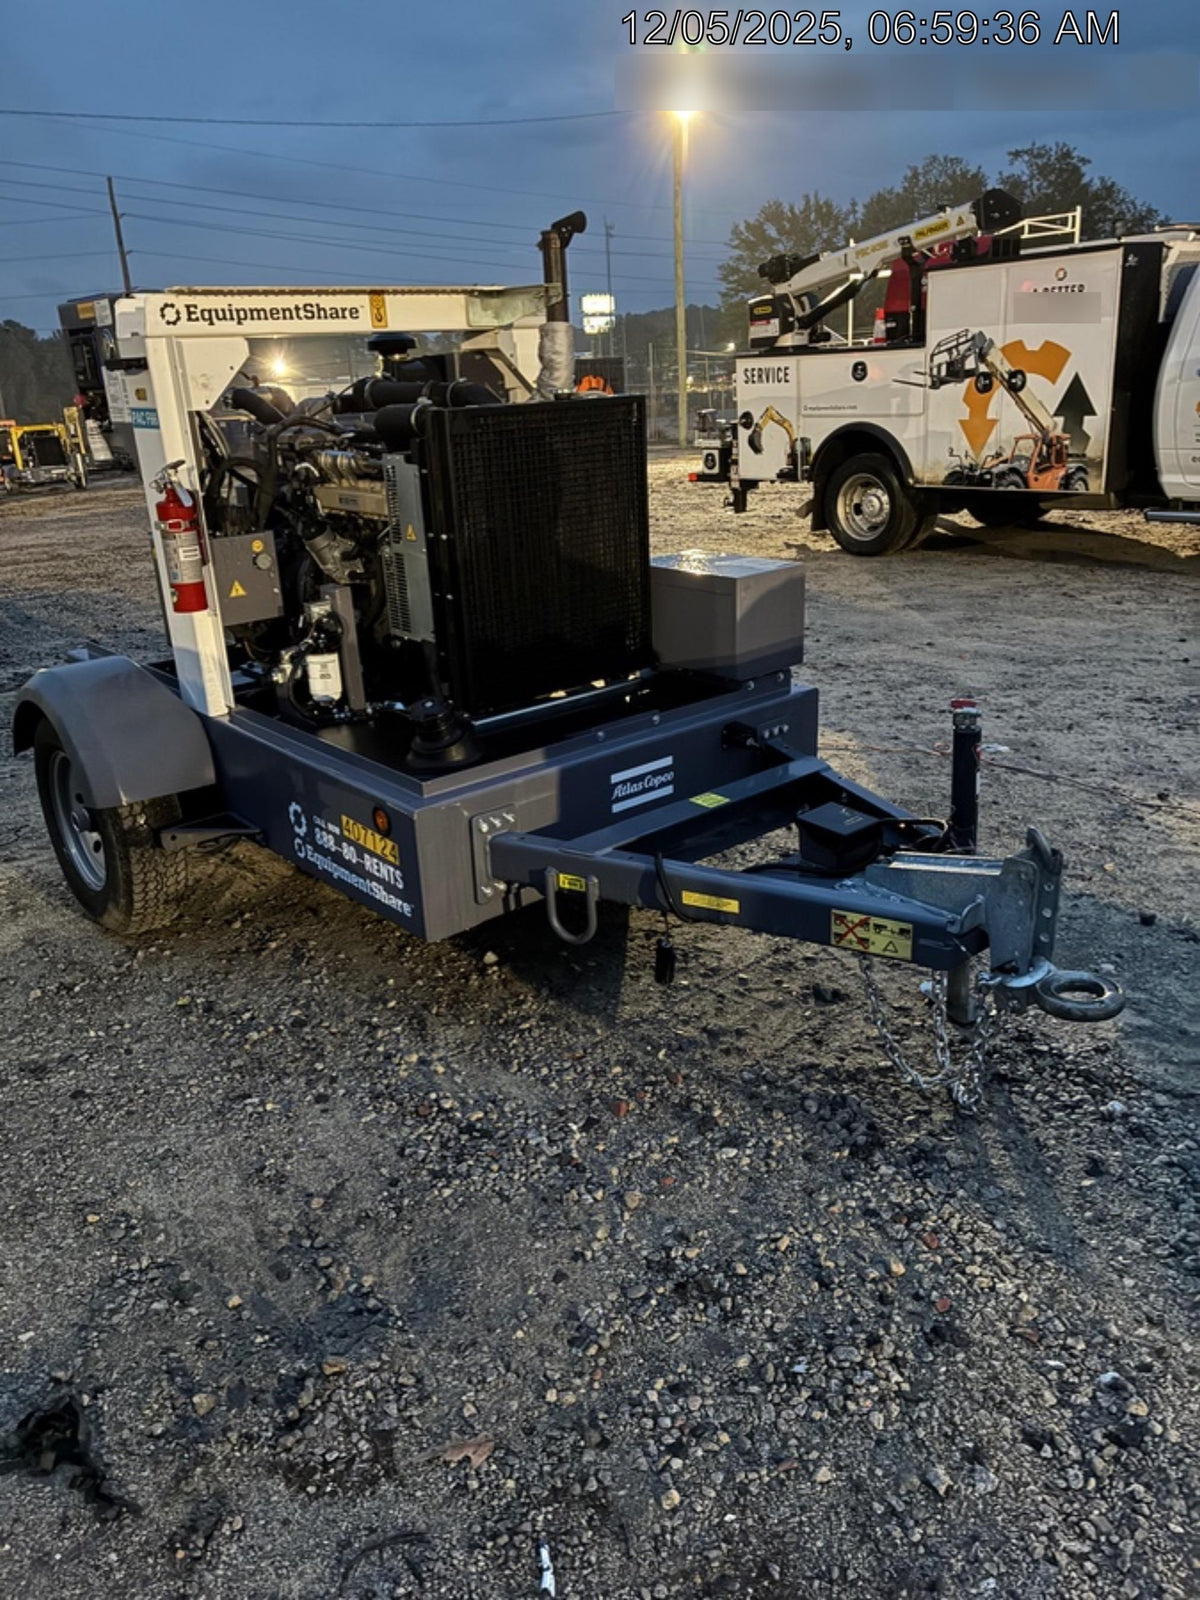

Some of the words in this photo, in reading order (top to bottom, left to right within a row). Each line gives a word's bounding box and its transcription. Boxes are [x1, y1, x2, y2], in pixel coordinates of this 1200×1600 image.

[184, 303, 360, 326] EquipmentShare
[743, 366, 790, 385] SERVICE
[611, 782, 643, 800] Atlas
[644, 771, 675, 788] Copco
[305, 844, 413, 918] EquipmentShare
